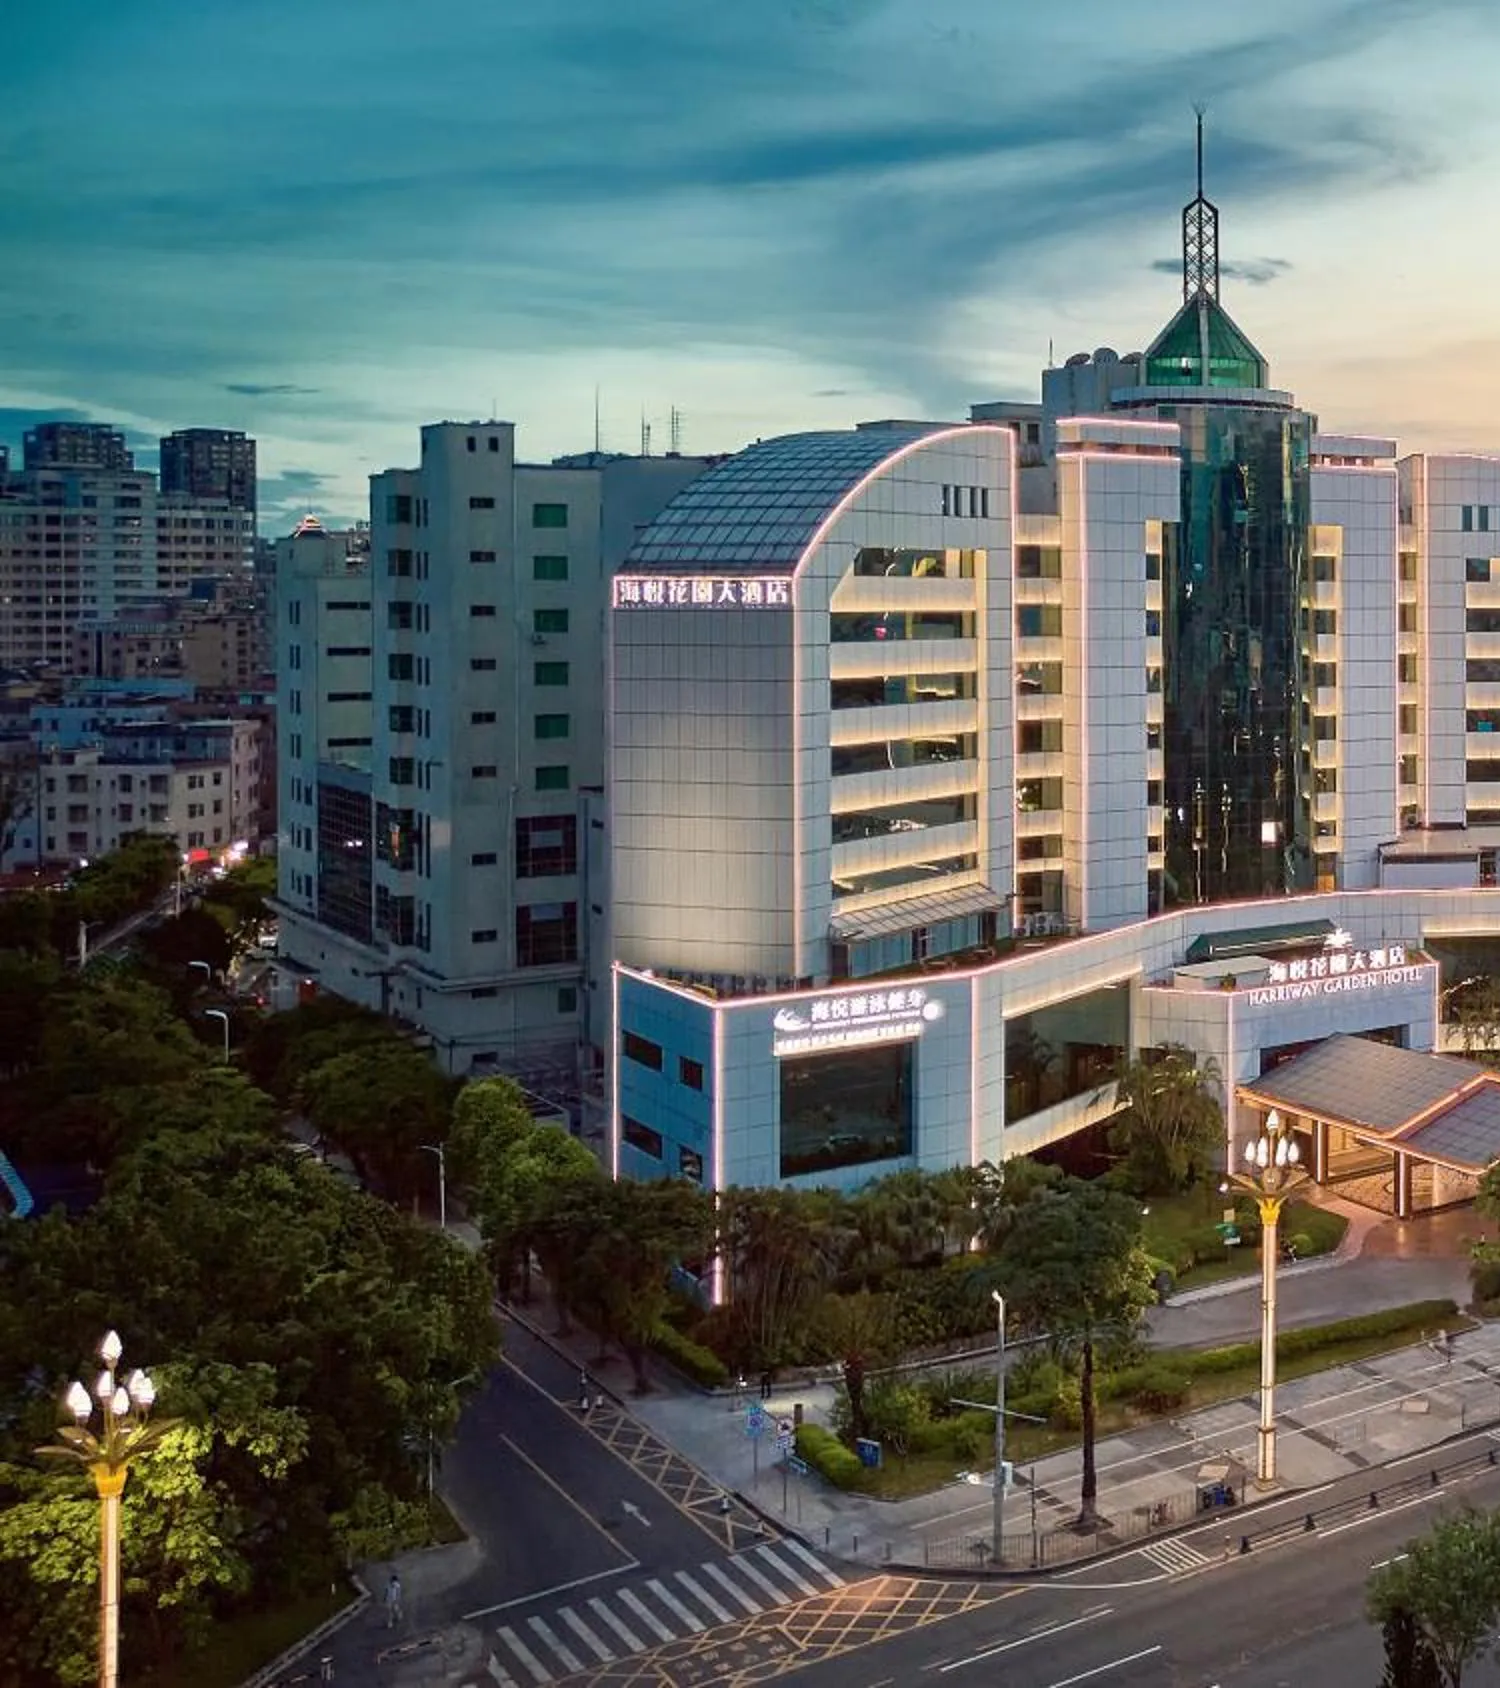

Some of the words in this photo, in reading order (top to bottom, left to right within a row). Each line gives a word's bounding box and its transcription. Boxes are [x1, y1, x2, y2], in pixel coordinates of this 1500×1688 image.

[1250, 981, 1319, 1005] HARRIWAY
[1324, 975, 1376, 993] GARDEN
[1383, 967, 1423, 983] HOTEL
